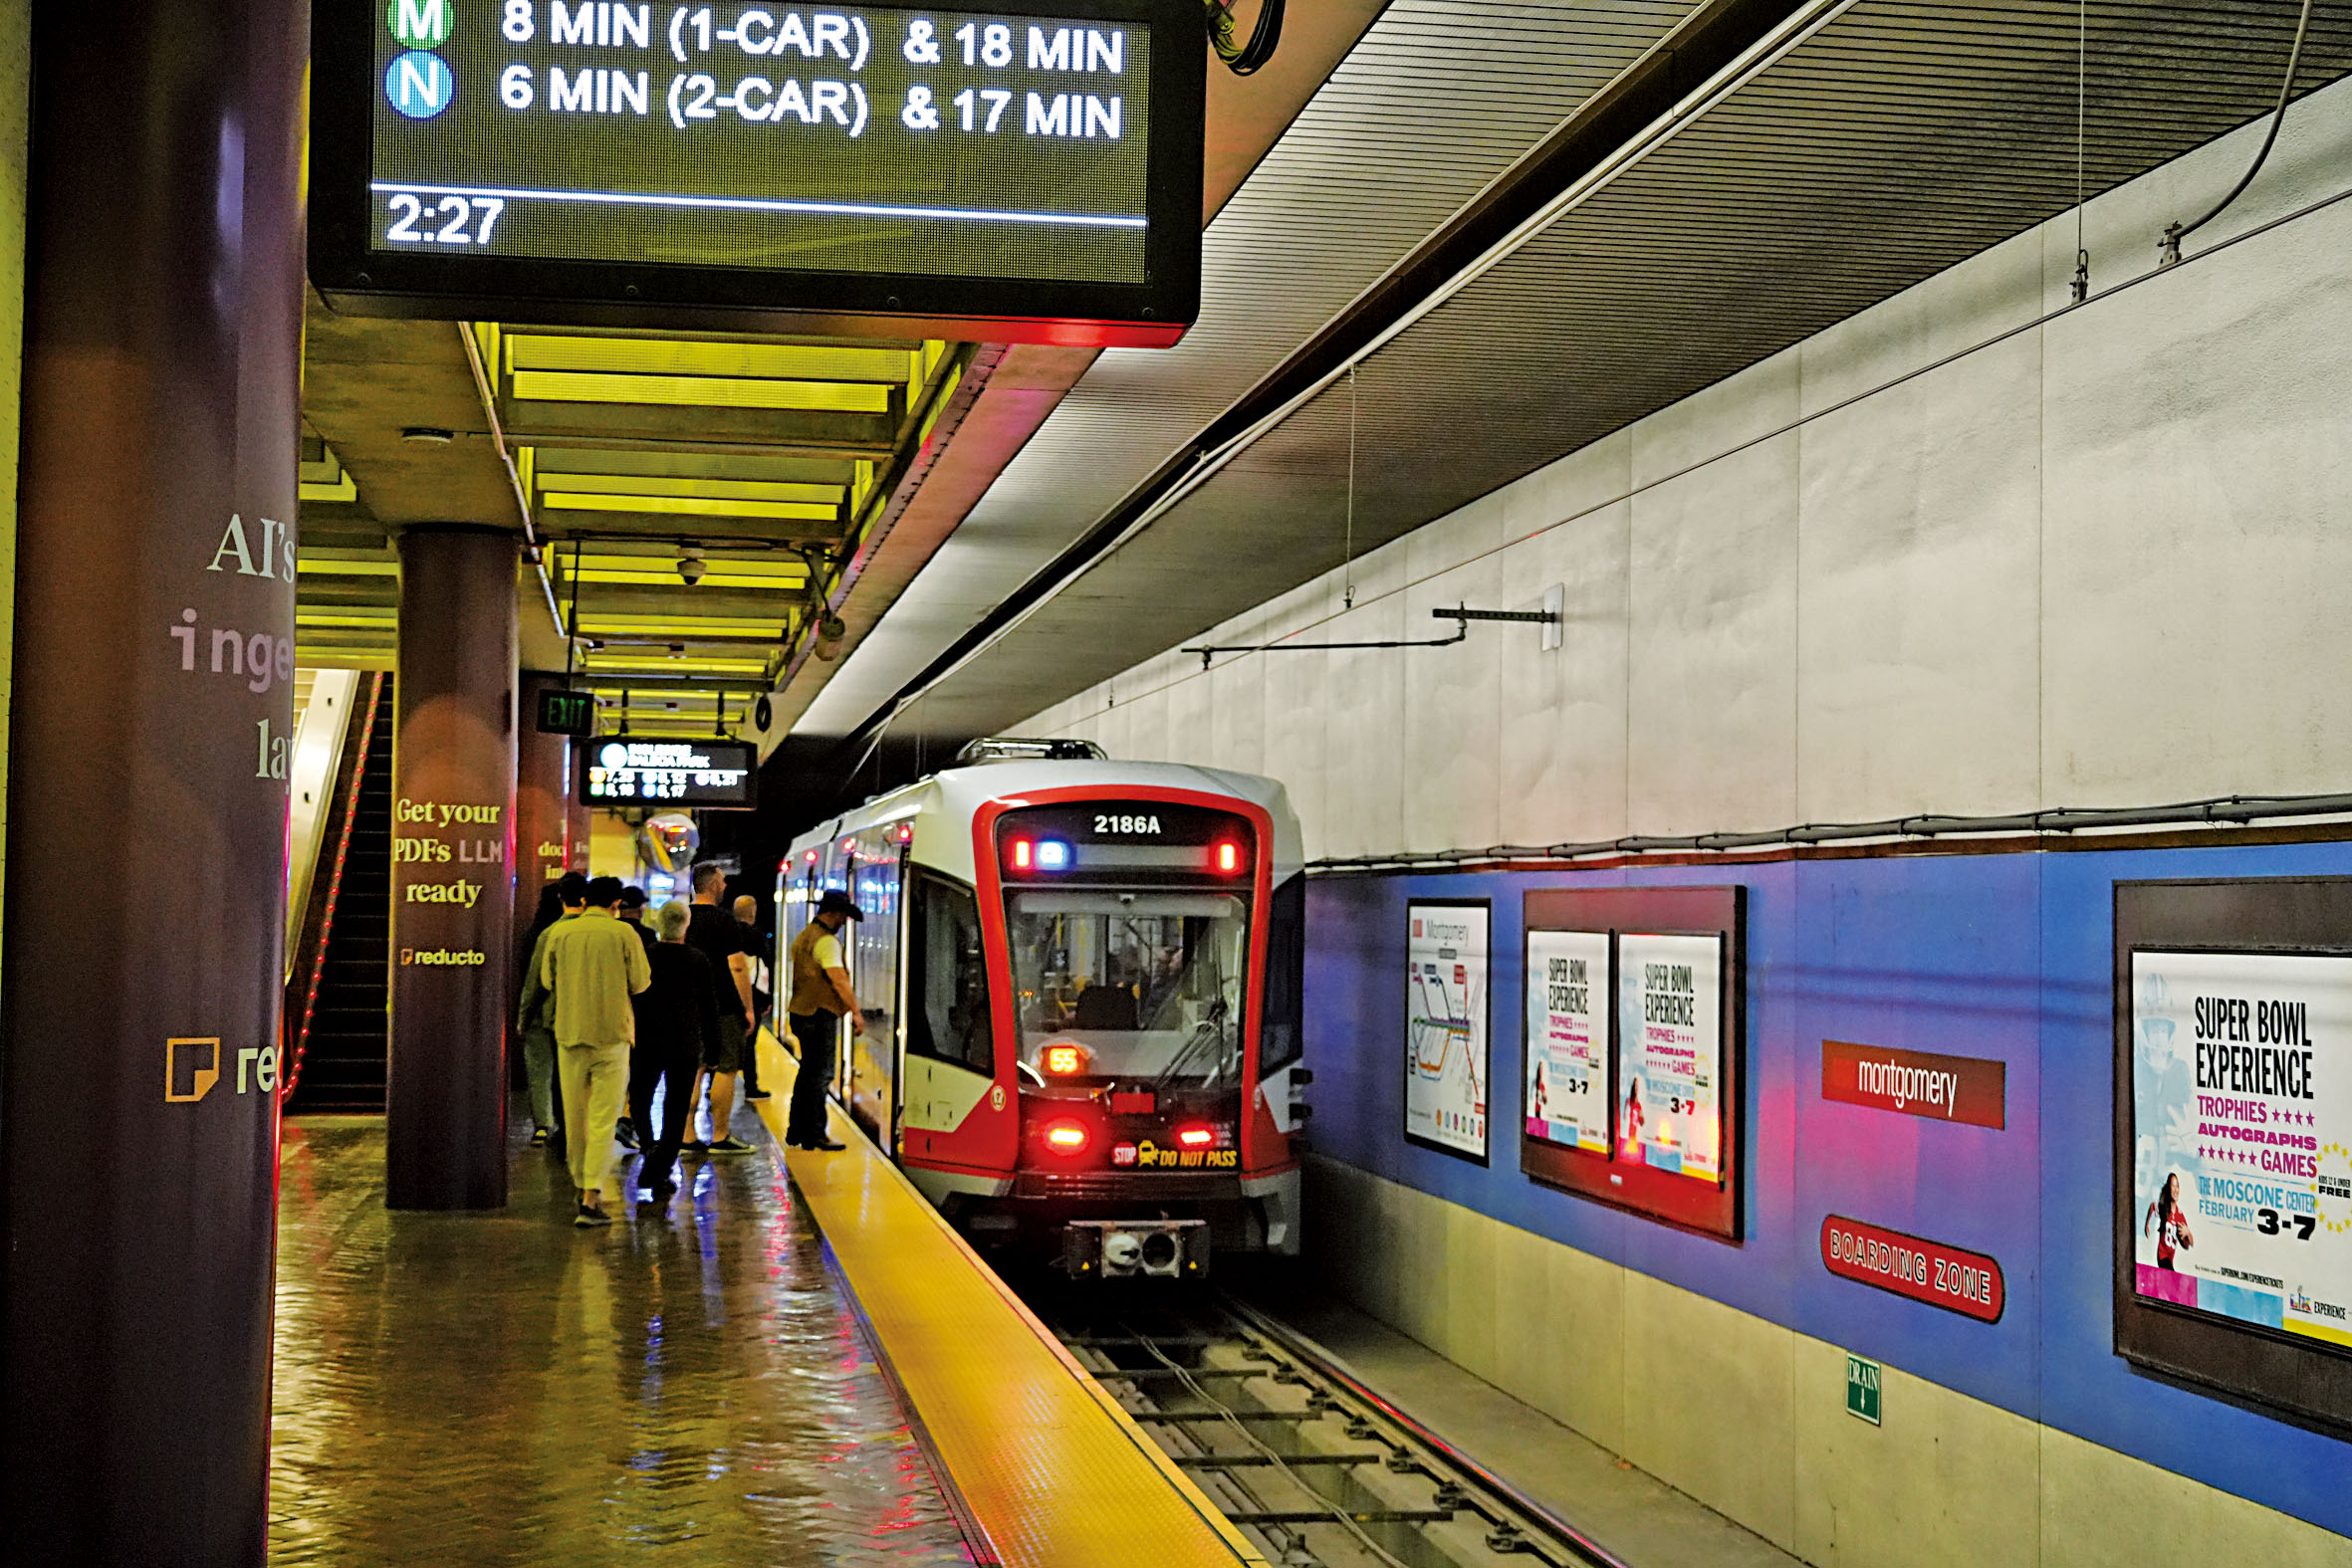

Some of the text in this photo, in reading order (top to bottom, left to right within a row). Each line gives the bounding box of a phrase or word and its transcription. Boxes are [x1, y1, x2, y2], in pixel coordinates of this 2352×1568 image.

[398, 0, 1123, 74] M 8 MIN (1-CAR) & 18 MIN
[399, 59, 1122, 139] N 6 MIN (2-CAR) & 17 MIN
[386, 194, 505, 245] 2:27
[207, 514, 296, 583] AI's
[549, 697, 586, 728] EXIT
[396, 798, 501, 828] Get your
[1094, 814, 1161, 834] 2186A
[393, 837, 451, 863] PDFs
[406, 879, 483, 909] ready
[414, 949, 486, 966] reducto
[1645, 963, 1694, 994] SUPER BOWL
[1645, 993, 1695, 1026] EXPERIENCE
[2195, 997, 2312, 1046] SUPER BOWL
[237, 1046, 277, 1094] re
[1673, 1059, 1696, 1075] GAMES
[2196, 1042, 2314, 1100] EXPERIENCE
[1859, 1058, 1958, 1117] montgomery
[2197, 1095, 2267, 1124] TROPHIES
[2198, 1122, 2317, 1151] AUTOGRAPHS
[1114, 1146, 1238, 1167] STOP DO NOT PASS
[2260, 1149, 2318, 1179] GAMES
[2199, 1176, 2316, 1214] THE MOSCONE CENTER
[2318, 1185, 2351, 1199] FREE
[2199, 1200, 2316, 1240] FEBRUARY 3-7
[1830, 1229, 1992, 1304] BOARDING ZONE
[2313, 1300, 2347, 1320] EXPERIENCE
[1848, 1360, 1879, 1391] DRAIN
